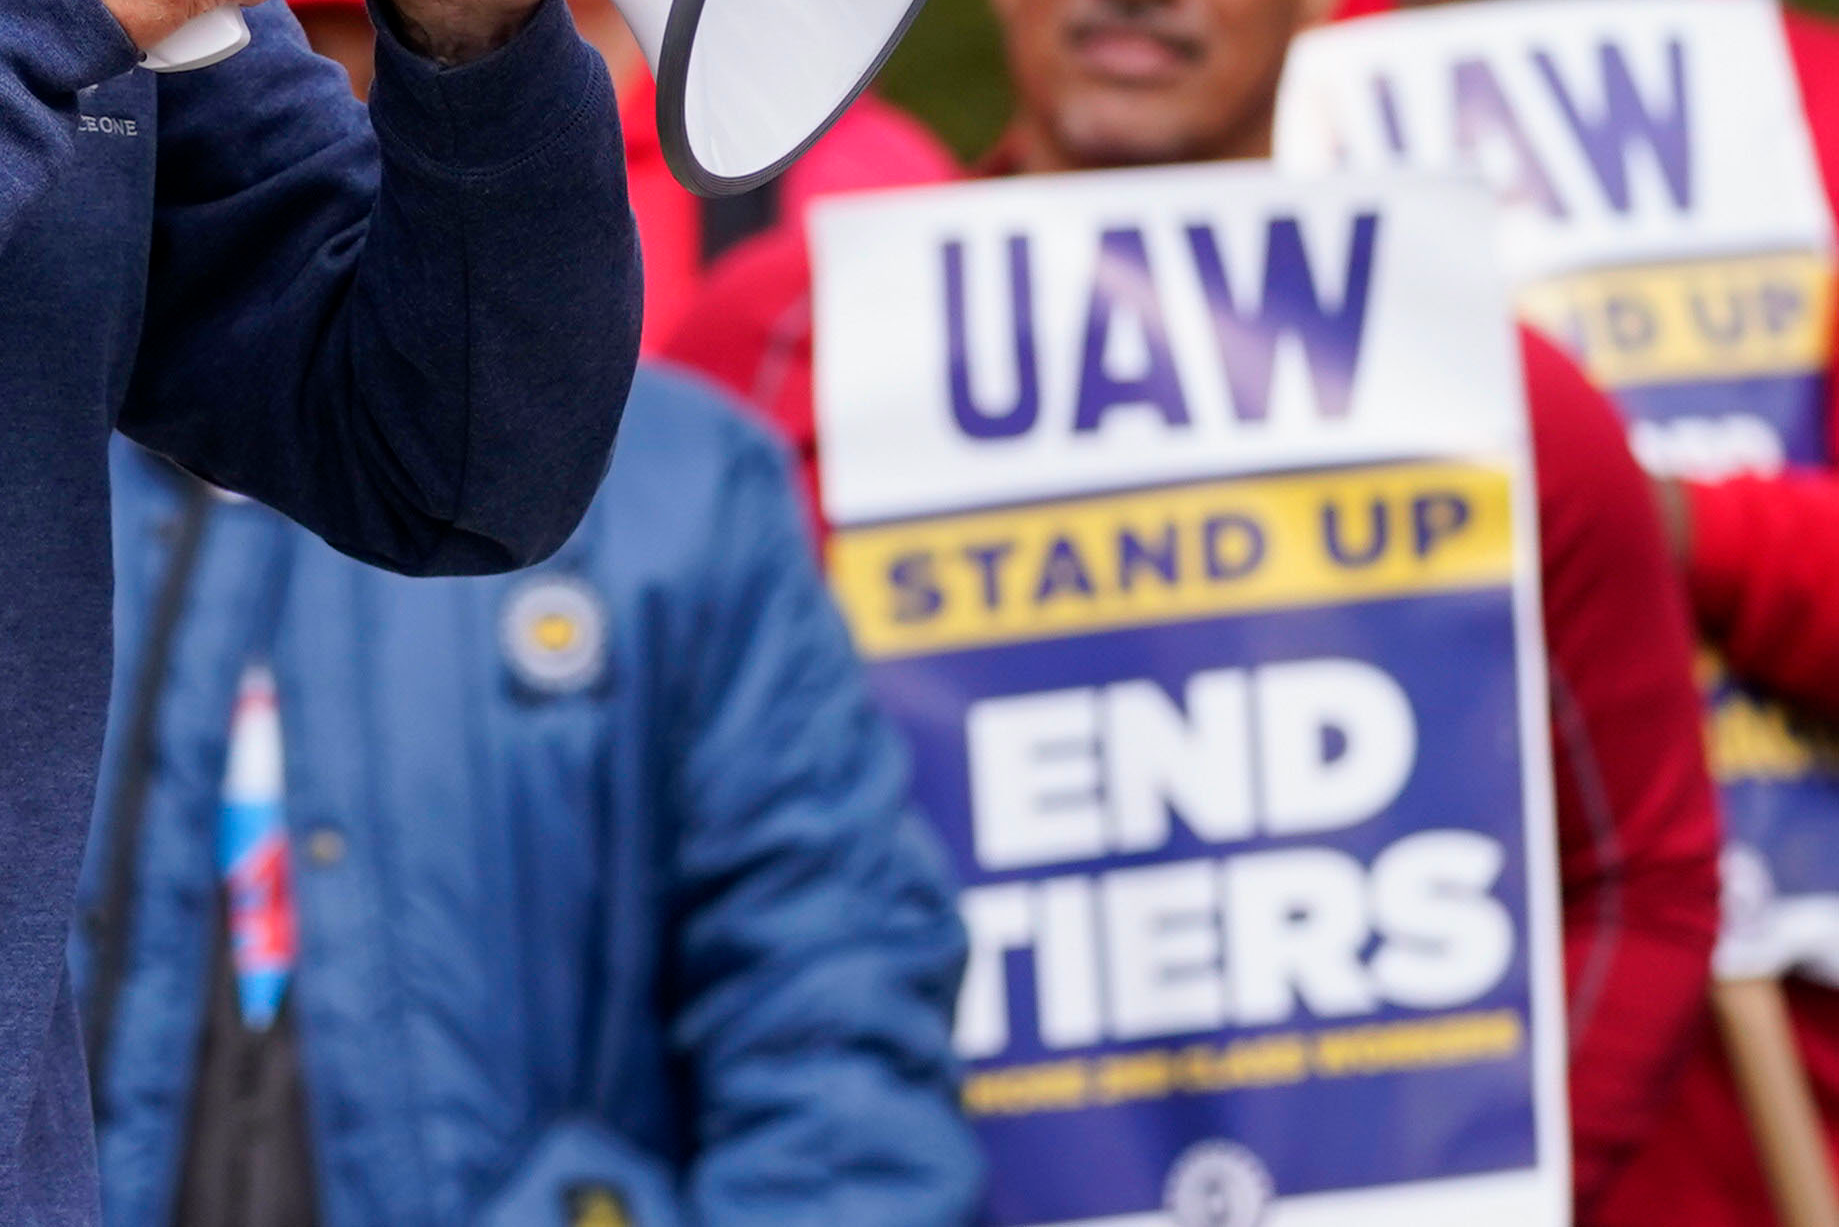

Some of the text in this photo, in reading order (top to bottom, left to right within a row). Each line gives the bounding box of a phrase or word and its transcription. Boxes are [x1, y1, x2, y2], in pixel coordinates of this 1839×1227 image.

[941, 212, 1381, 443] UAW
[1690, 282, 1804, 347] UP
[885, 491, 1472, 624] STAND UP
[966, 657, 1419, 871] END
[953, 828, 1516, 1059] TIERS
